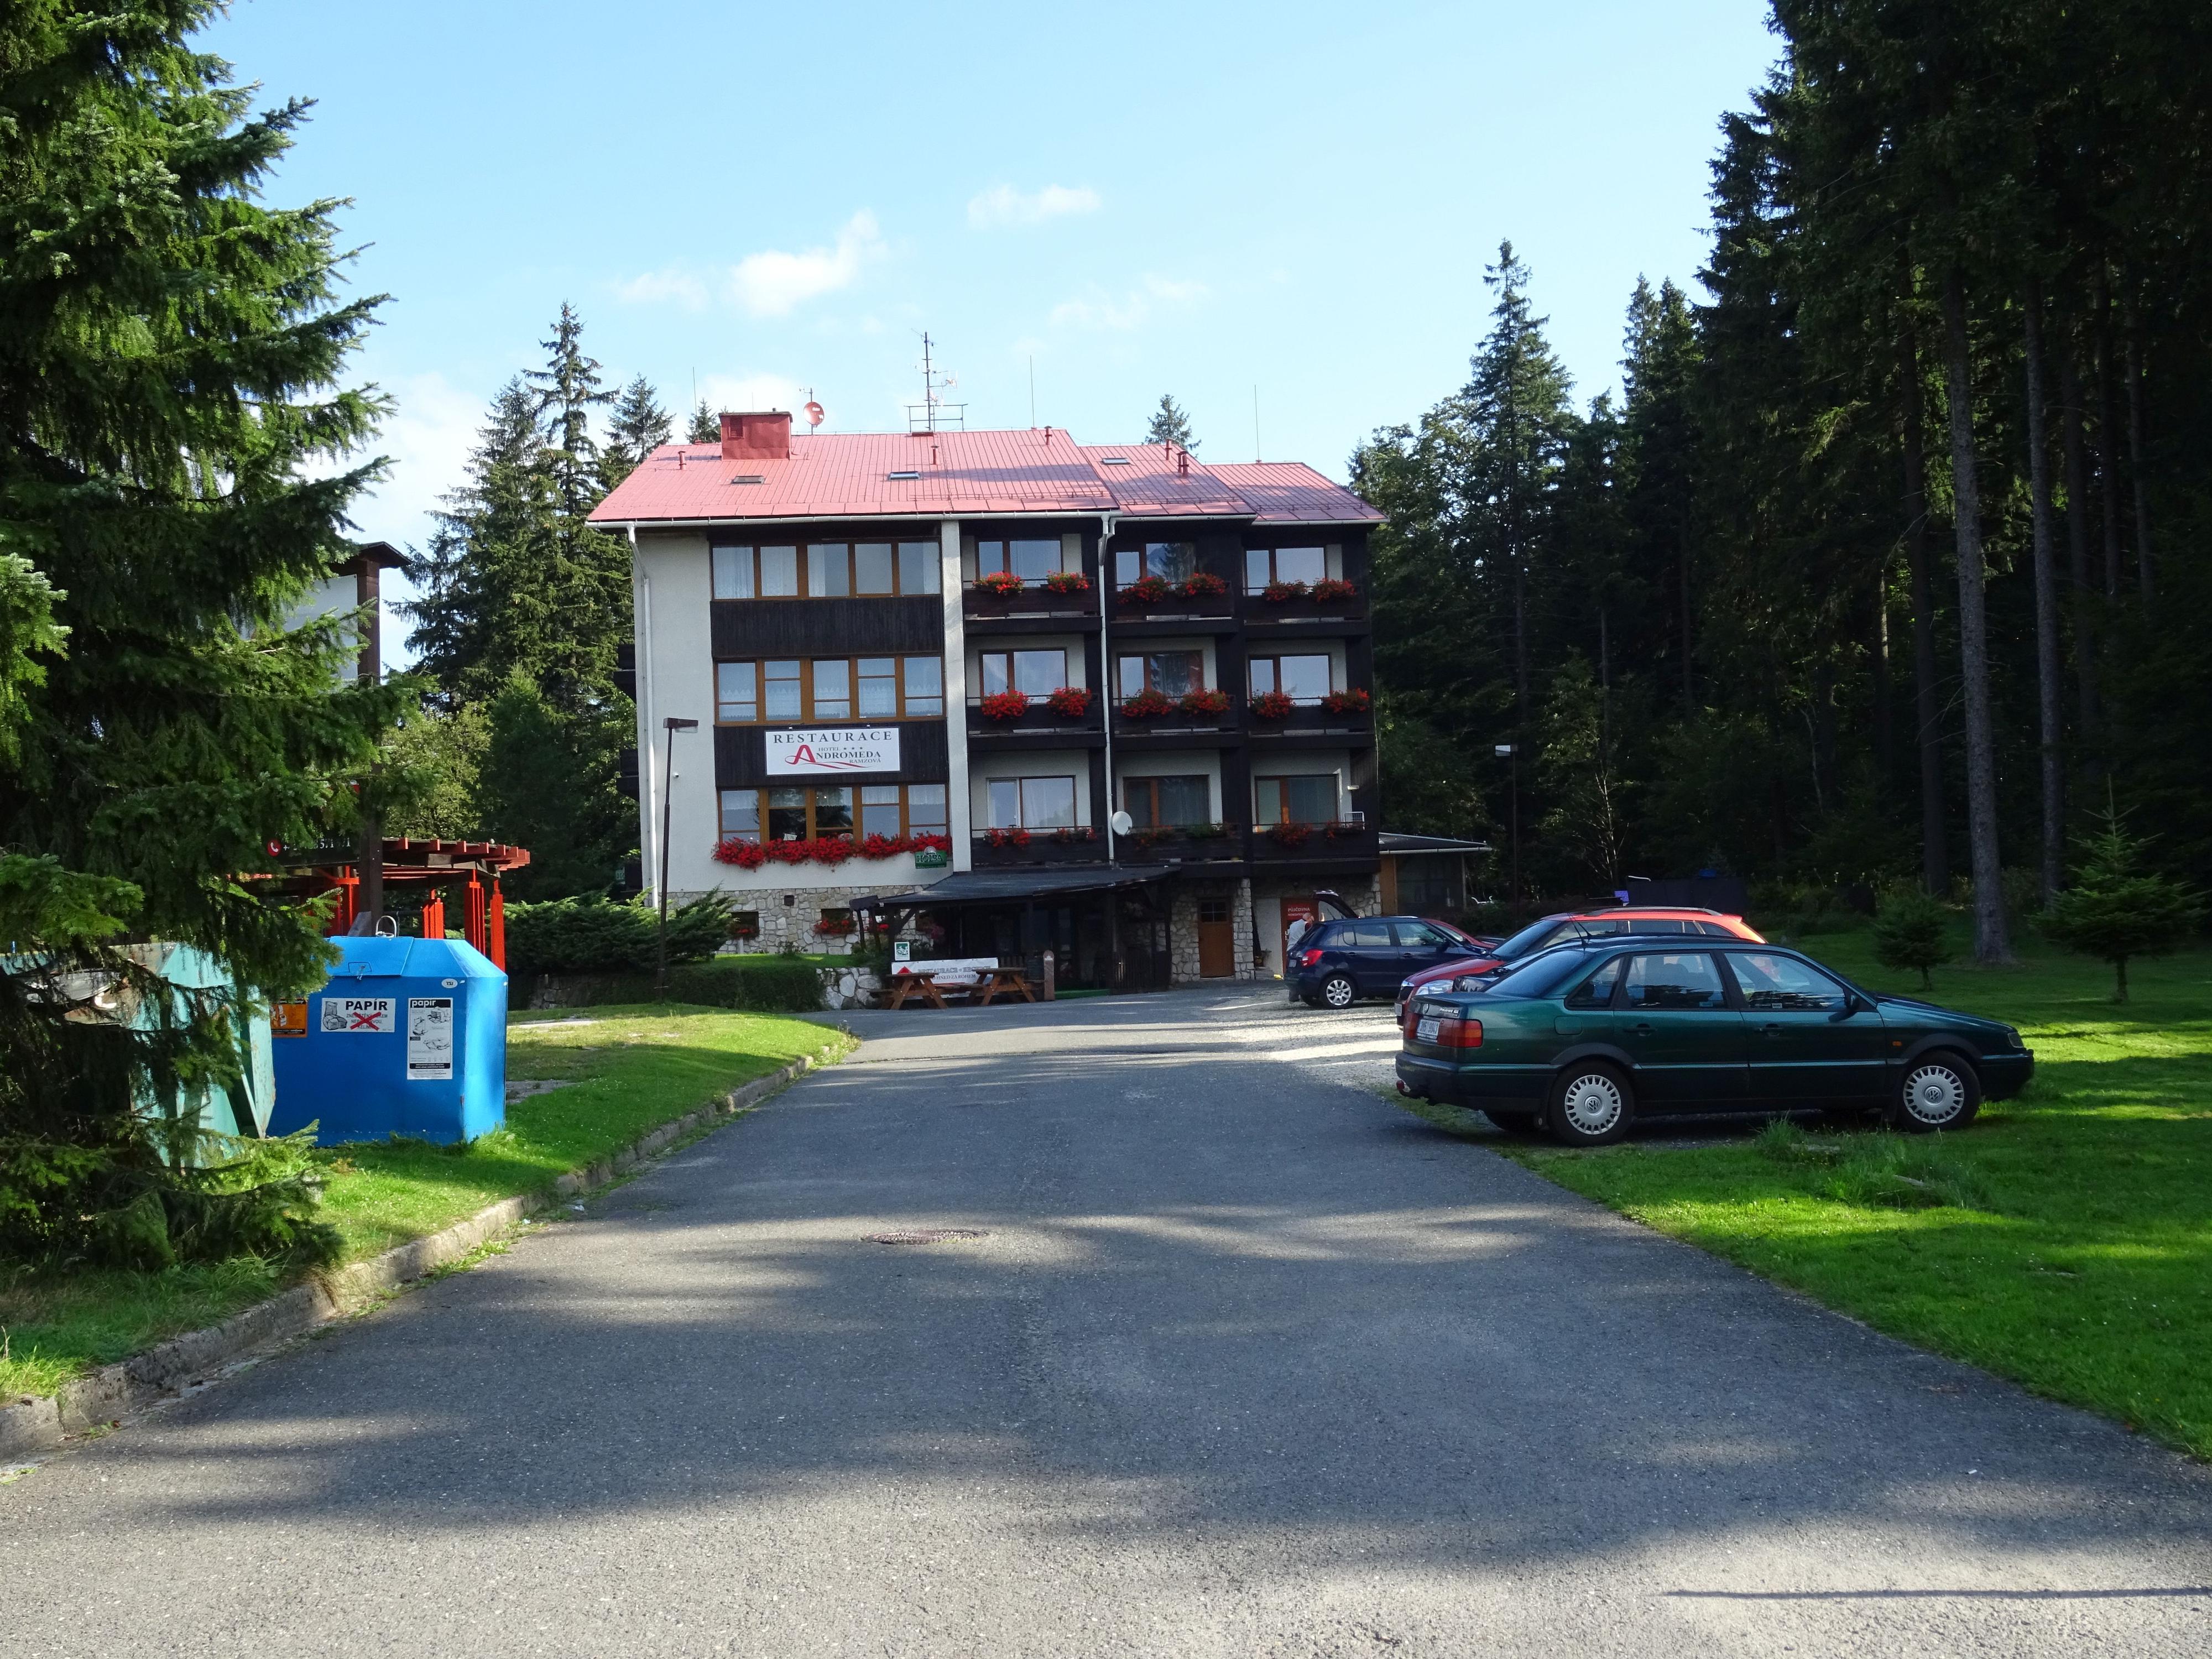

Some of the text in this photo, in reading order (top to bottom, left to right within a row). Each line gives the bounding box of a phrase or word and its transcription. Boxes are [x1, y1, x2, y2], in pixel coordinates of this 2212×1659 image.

[774, 731, 892, 743] RESTAURACE
[786, 745, 881, 765] ANDROMEDA
[346, 999, 388, 1010] PAPÍR
